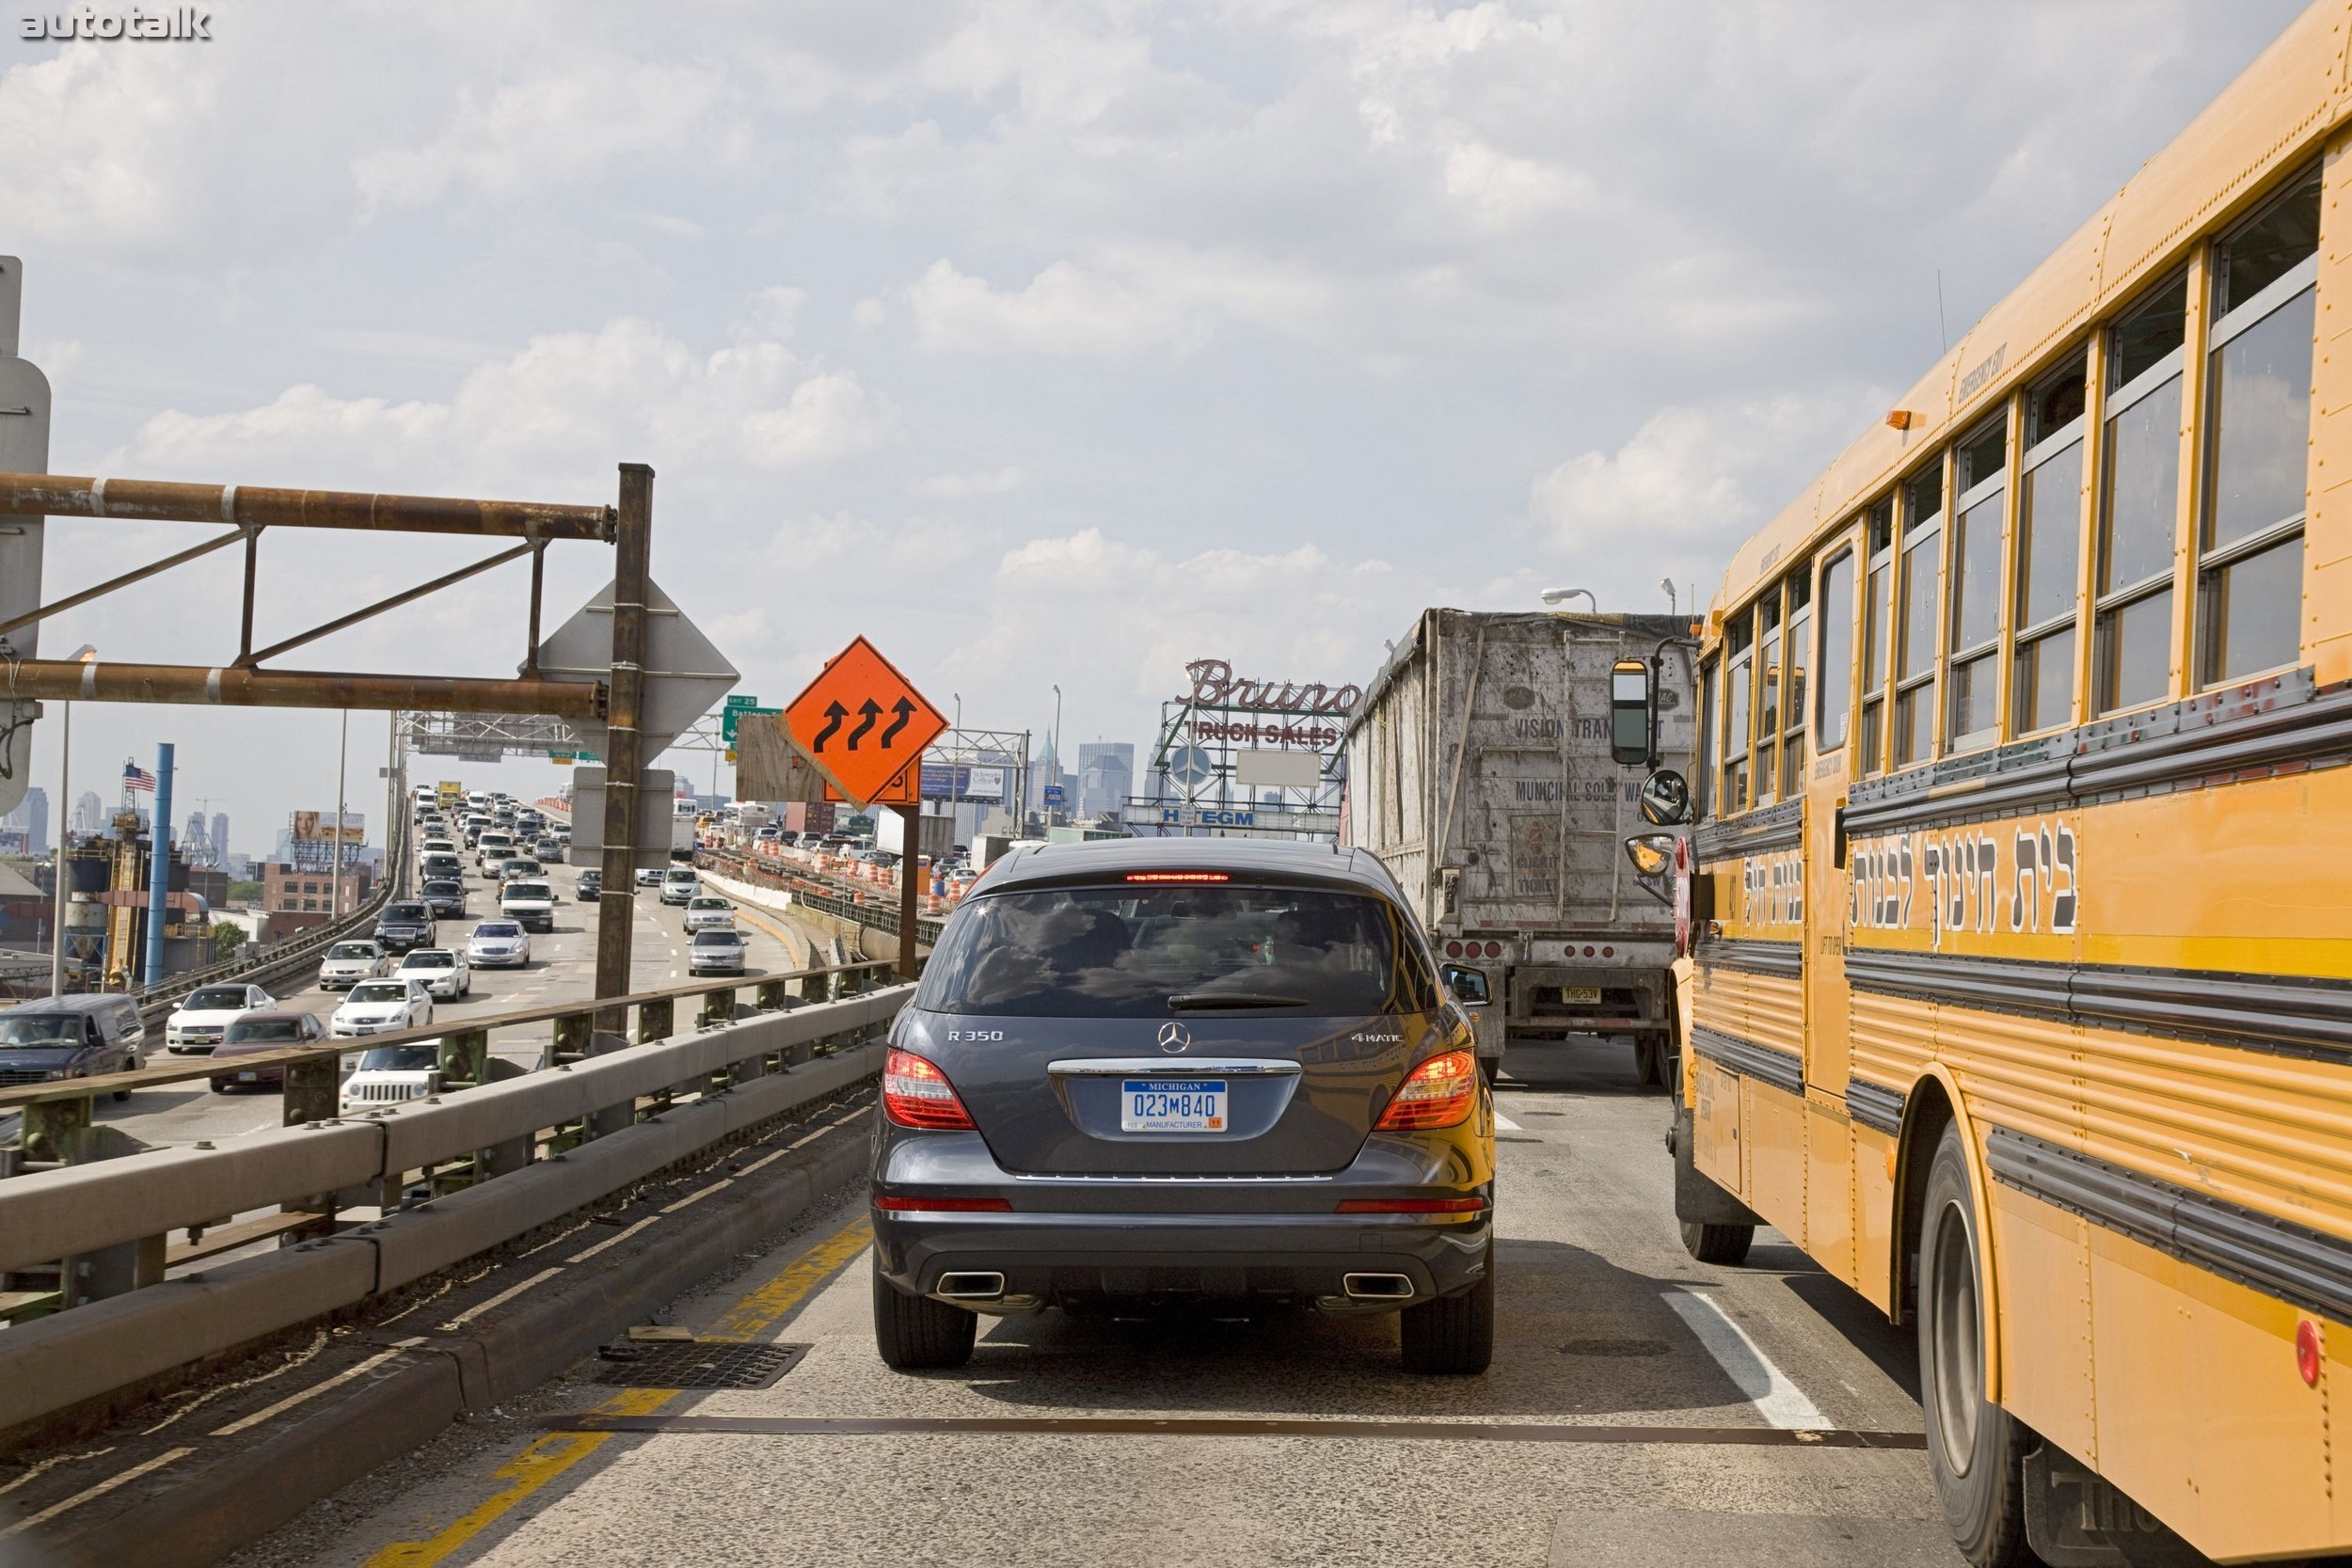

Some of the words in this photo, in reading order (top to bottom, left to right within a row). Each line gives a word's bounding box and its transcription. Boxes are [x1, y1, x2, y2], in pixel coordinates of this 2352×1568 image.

[1175, 659, 1363, 712] Bruno
[1184, 721, 1258, 743] TRUCK
[1264, 724, 1337, 747] SALES
[1515, 719, 1564, 739] VISION
[1851, 833, 1913, 931] לבנות
[1924, 830, 1997, 953] חינוך
[2011, 818, 2077, 935] בית
[947, 1030, 960, 1041] R
[964, 1030, 1004, 1041] 350
[1149, 1083, 1200, 1091] MICHIGAN
